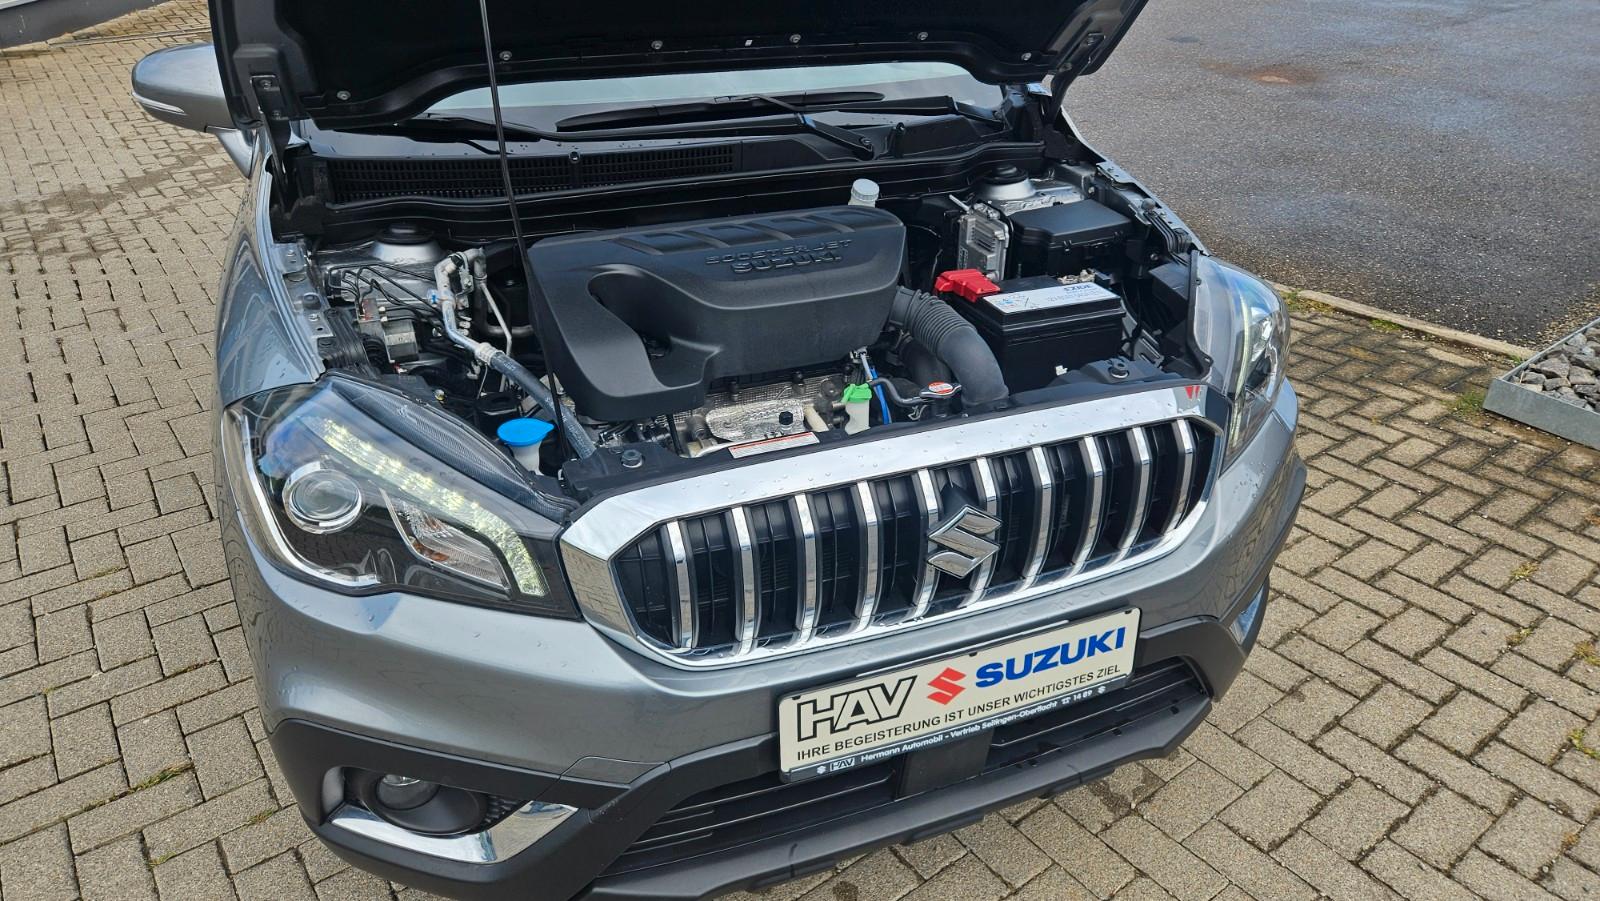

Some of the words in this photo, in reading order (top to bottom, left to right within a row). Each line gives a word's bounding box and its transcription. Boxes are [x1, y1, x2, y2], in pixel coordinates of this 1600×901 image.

[731, 251, 843, 274] SUZUKI
[975, 627, 1126, 688] SUZUKI
[797, 675, 918, 742] HAV
[797, 745, 830, 761] IHRE
[834, 716, 941, 751] BEGEISTERUNG
[944, 709, 965, 723] IST
[968, 697, 1010, 716] UNSER
[1014, 672, 1094, 703] WICHTIGSTES
[1096, 664, 1121, 679] ZIEL
[860, 747, 901, 762] Hermann
[901, 736, 943, 751] Automobil
[950, 724, 981, 739] Vertrieb
